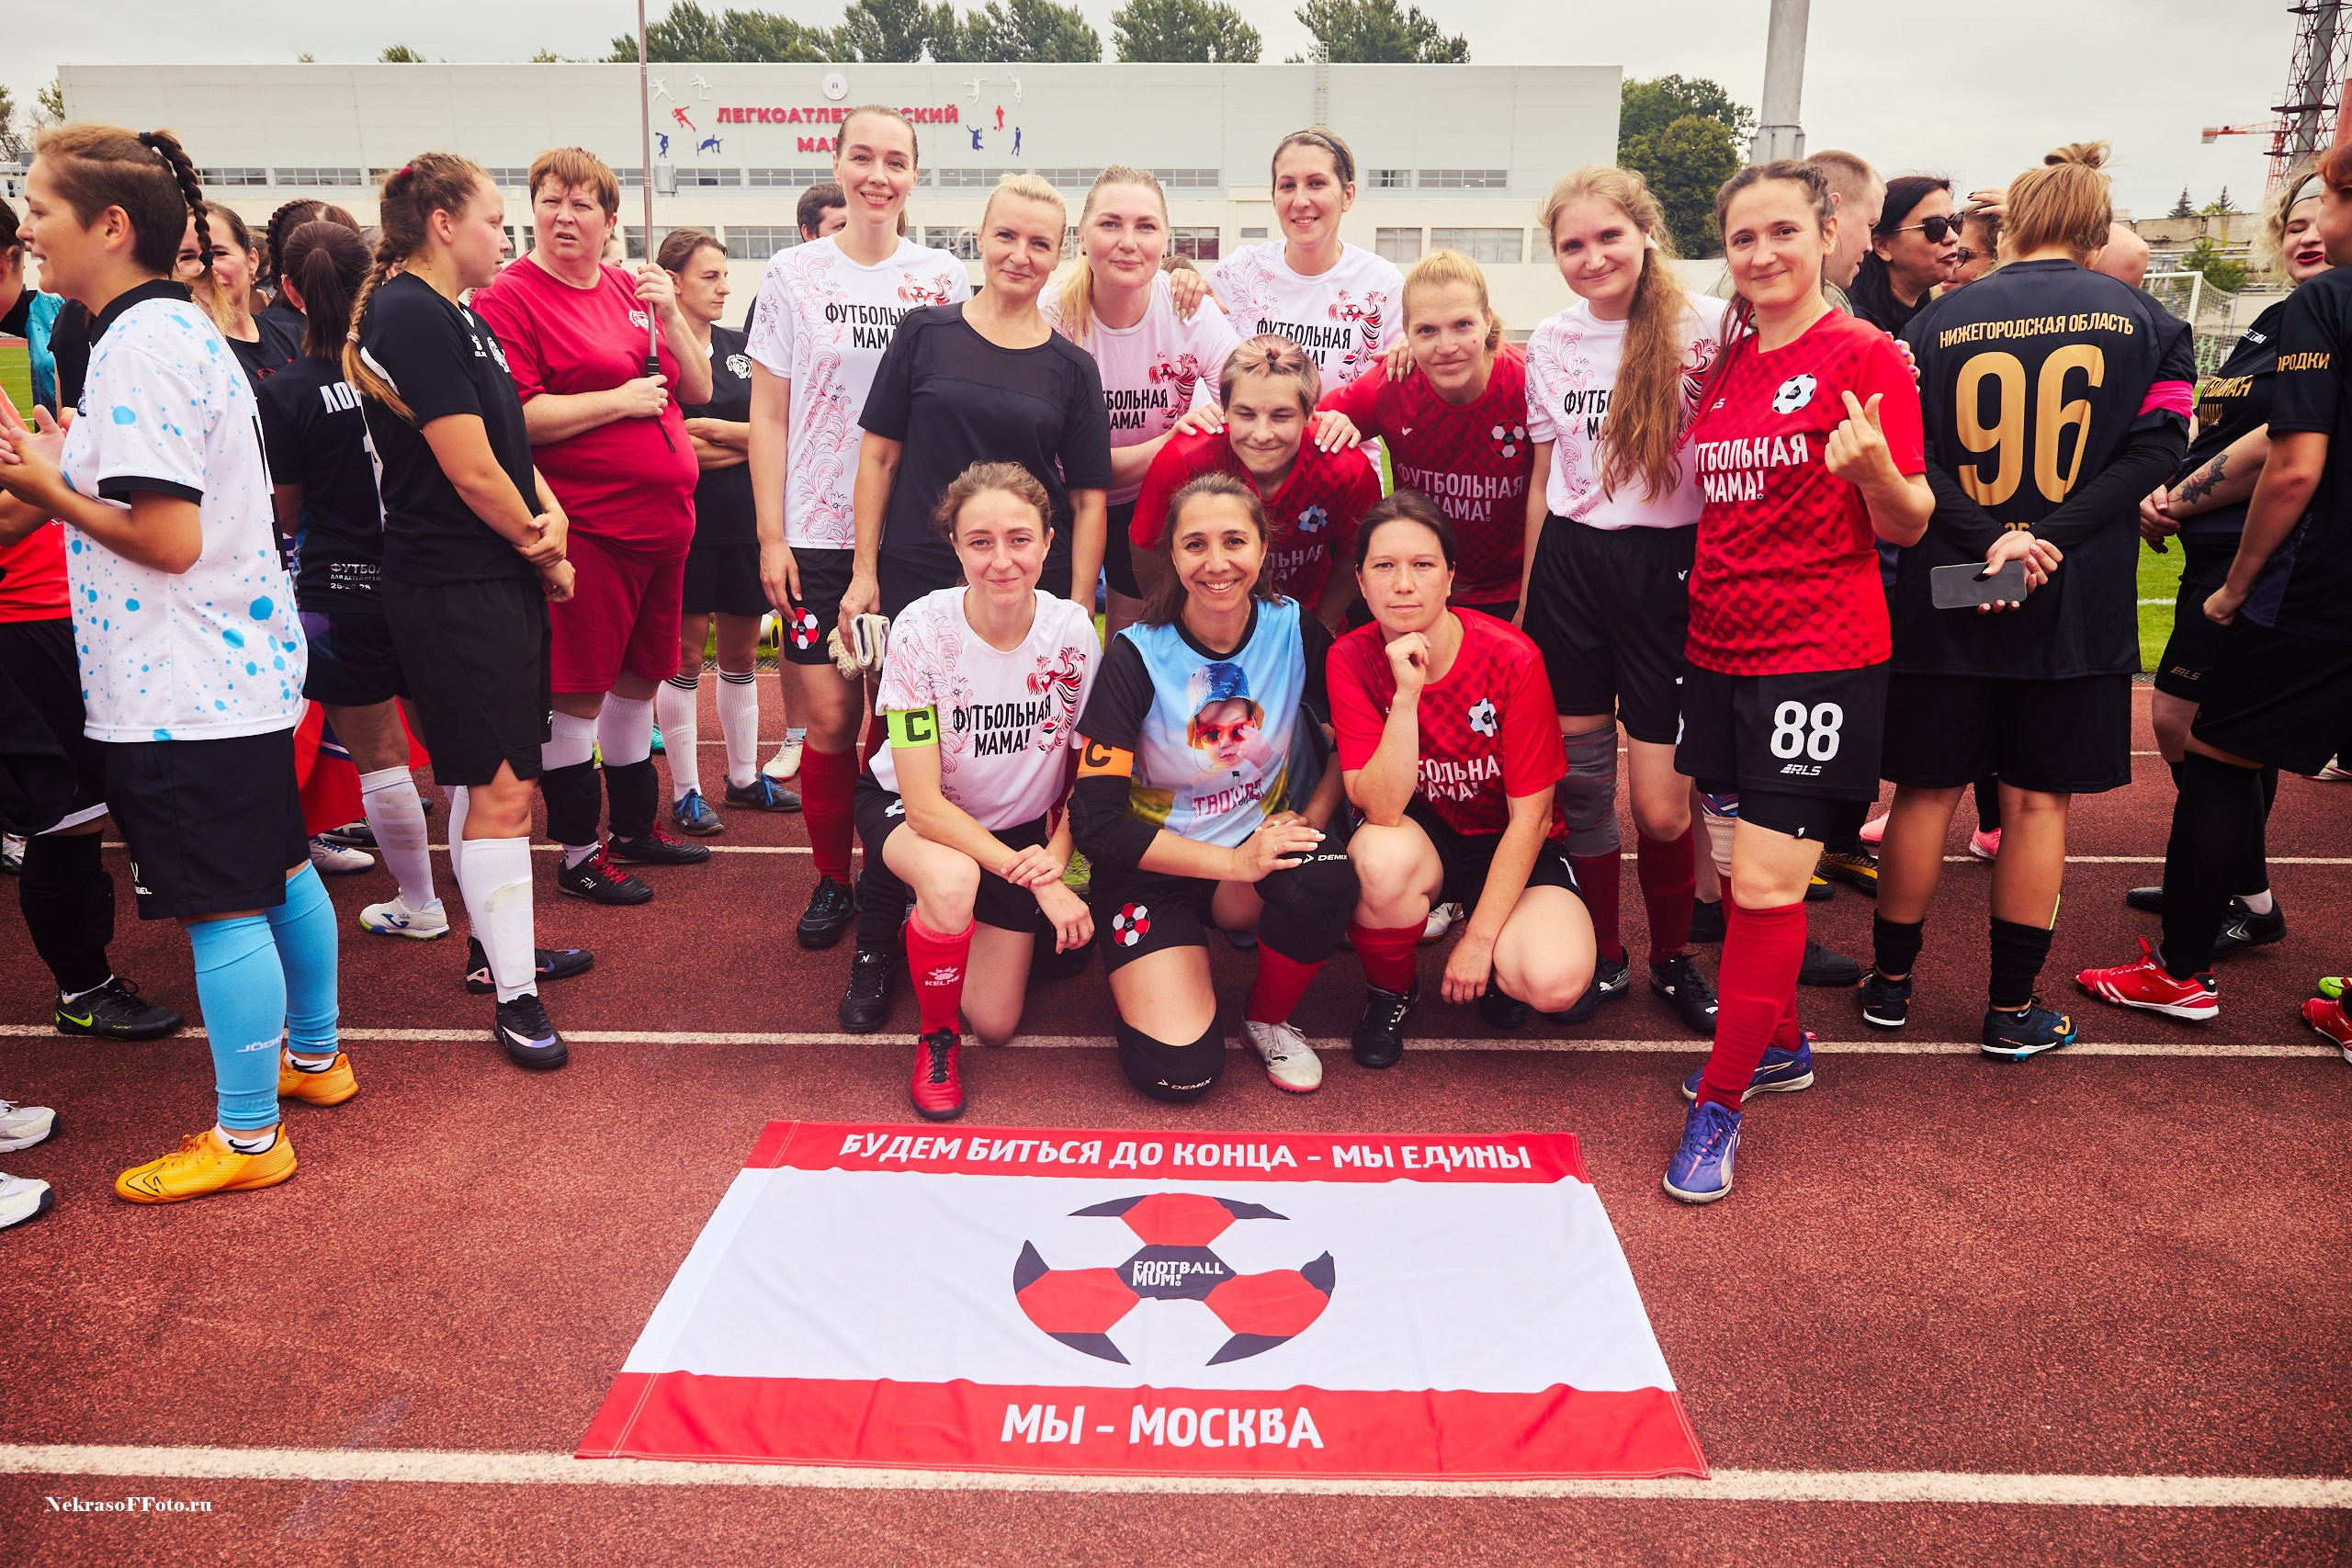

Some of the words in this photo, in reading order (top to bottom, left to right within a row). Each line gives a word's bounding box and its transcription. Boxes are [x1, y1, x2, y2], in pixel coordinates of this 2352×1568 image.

[717, 104, 959, 124] ЛЕГКОАТЛЕСКИЙ
[1939, 314, 2067, 350] НИЖЕГОРОДСКАЯ
[2068, 312, 2135, 336] ОБЛАСТЬ
[1102, 389, 1169, 411] БОЛЬНАЯ
[1110, 411, 1147, 431] АМА!
[1955, 344, 2106, 506] 96
[1396, 462, 1525, 499] ФУТБОЛЬНАЯ
[1702, 469, 1764, 503] МАМА!
[904, 710, 932, 743] C
[952, 694, 1052, 734] ФУТБОЛЬНАЯ
[1770, 700, 1844, 761] 88
[974, 728, 1031, 758] МАМА!
[1171, 1077, 1212, 1090] DEMIX
[839, 1134, 962, 1163] БУДЕМ
[967, 1136, 1102, 1165] БИТЬСЯ
[1108, 1142, 1163, 1169] ДО
[1172, 1142, 1298, 1172] КОНЦА
[1331, 1145, 1395, 1168] МЫ
[1402, 1145, 1532, 1173] ЕДИНЫ
[1132, 1269, 1182, 1287] MUM!
[1134, 1260, 1224, 1275] FOOTBALL
[1001, 1404, 1085, 1445] МЫ
[1128, 1404, 1324, 1449] МОСКВА
